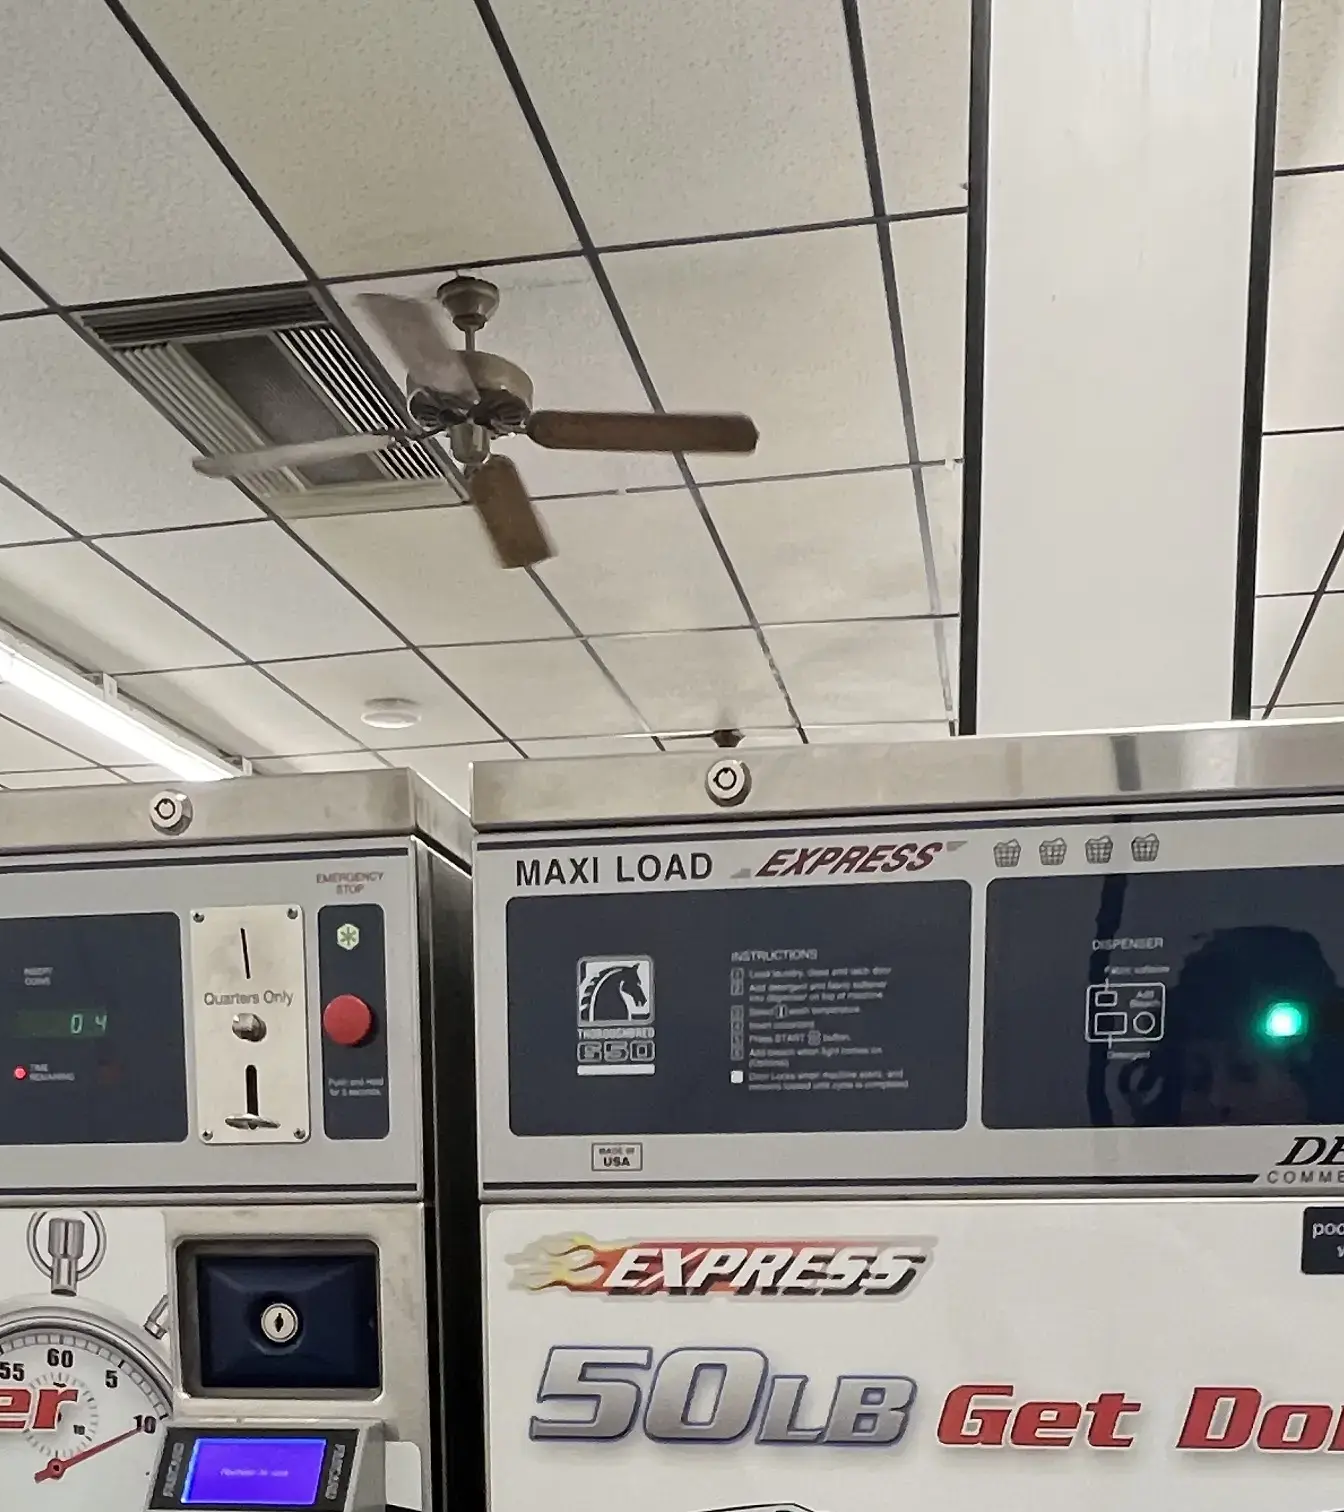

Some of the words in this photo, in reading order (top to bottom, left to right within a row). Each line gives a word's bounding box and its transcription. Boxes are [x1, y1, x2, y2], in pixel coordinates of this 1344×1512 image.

[515, 856, 599, 887] MAXI
[616, 852, 712, 884] LOAD
[755, 842, 943, 878] EXPRESS
[316, 871, 384, 884] EMERGENCY
[336, 884, 364, 894] STOP
[1092, 937, 1164, 951] DISPENSER
[731, 949, 818, 962] INSTRUCTIONS
[204, 991, 260, 1006] Quarters
[263, 989, 294, 1007] Only
[603, 1156, 630, 1167] USA
[602, 1244, 927, 1294] EXPRESS
[46, 1348, 74, 1370] 60
[0, 1361, 25, 1382] 55
[104, 1368, 118, 1390] 5
[529, 1346, 918, 1447] 50LB
[937, 1384, 1142, 1451] Get
[133, 1415, 157, 1434] 10
